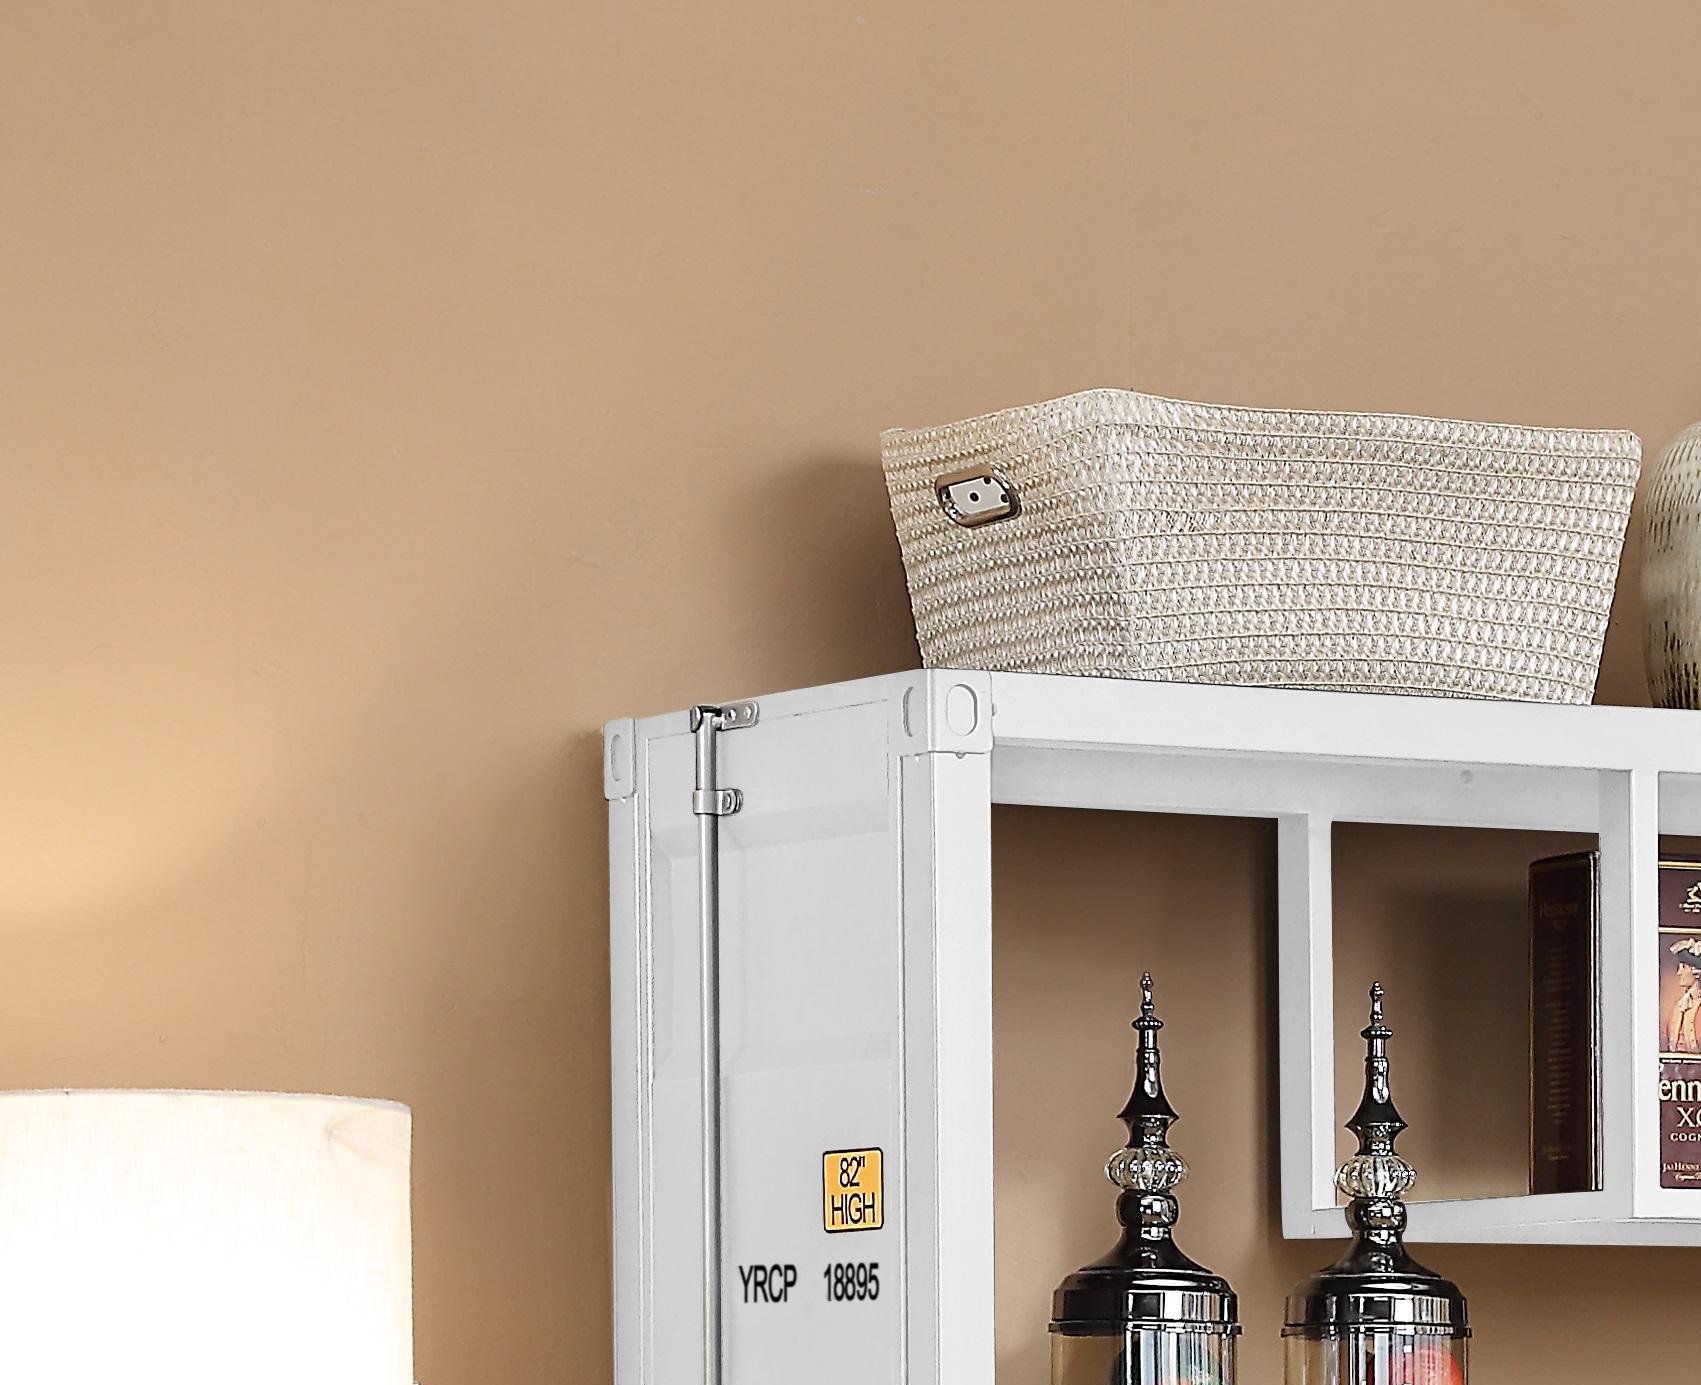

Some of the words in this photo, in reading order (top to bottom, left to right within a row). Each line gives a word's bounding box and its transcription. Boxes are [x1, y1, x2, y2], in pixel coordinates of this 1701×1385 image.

[831, 1192, 876, 1225] HIGH
[738, 1263, 798, 1303] YRCP
[823, 1262, 880, 1301] 18895
